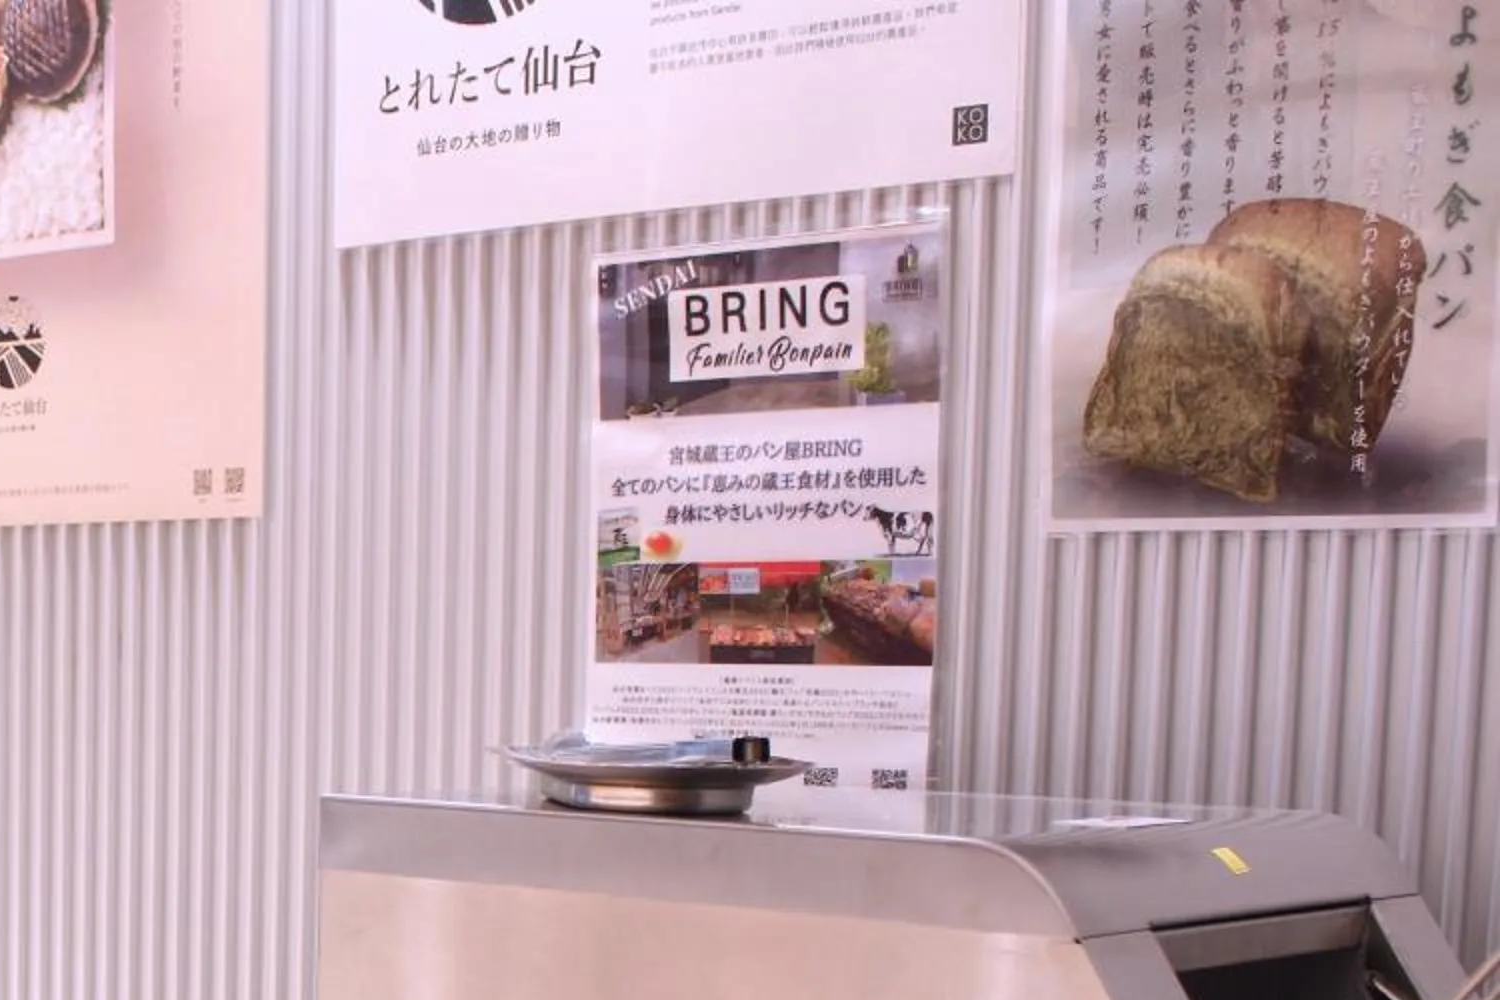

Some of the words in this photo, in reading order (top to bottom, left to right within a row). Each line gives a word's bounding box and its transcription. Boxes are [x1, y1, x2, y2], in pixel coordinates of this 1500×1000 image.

[378, 38, 603, 116] とれたて仙台
[416, 119, 562, 157] 仙台の大地の贈り物
[1429, 4, 1482, 331] よもぎ食パン
[613, 259, 700, 320] SENDAI
[684, 281, 851, 337] BRING
[768, 334, 854, 373] Bonpain
[669, 437, 863, 466] 宮城蔵王のパン屋BRING
